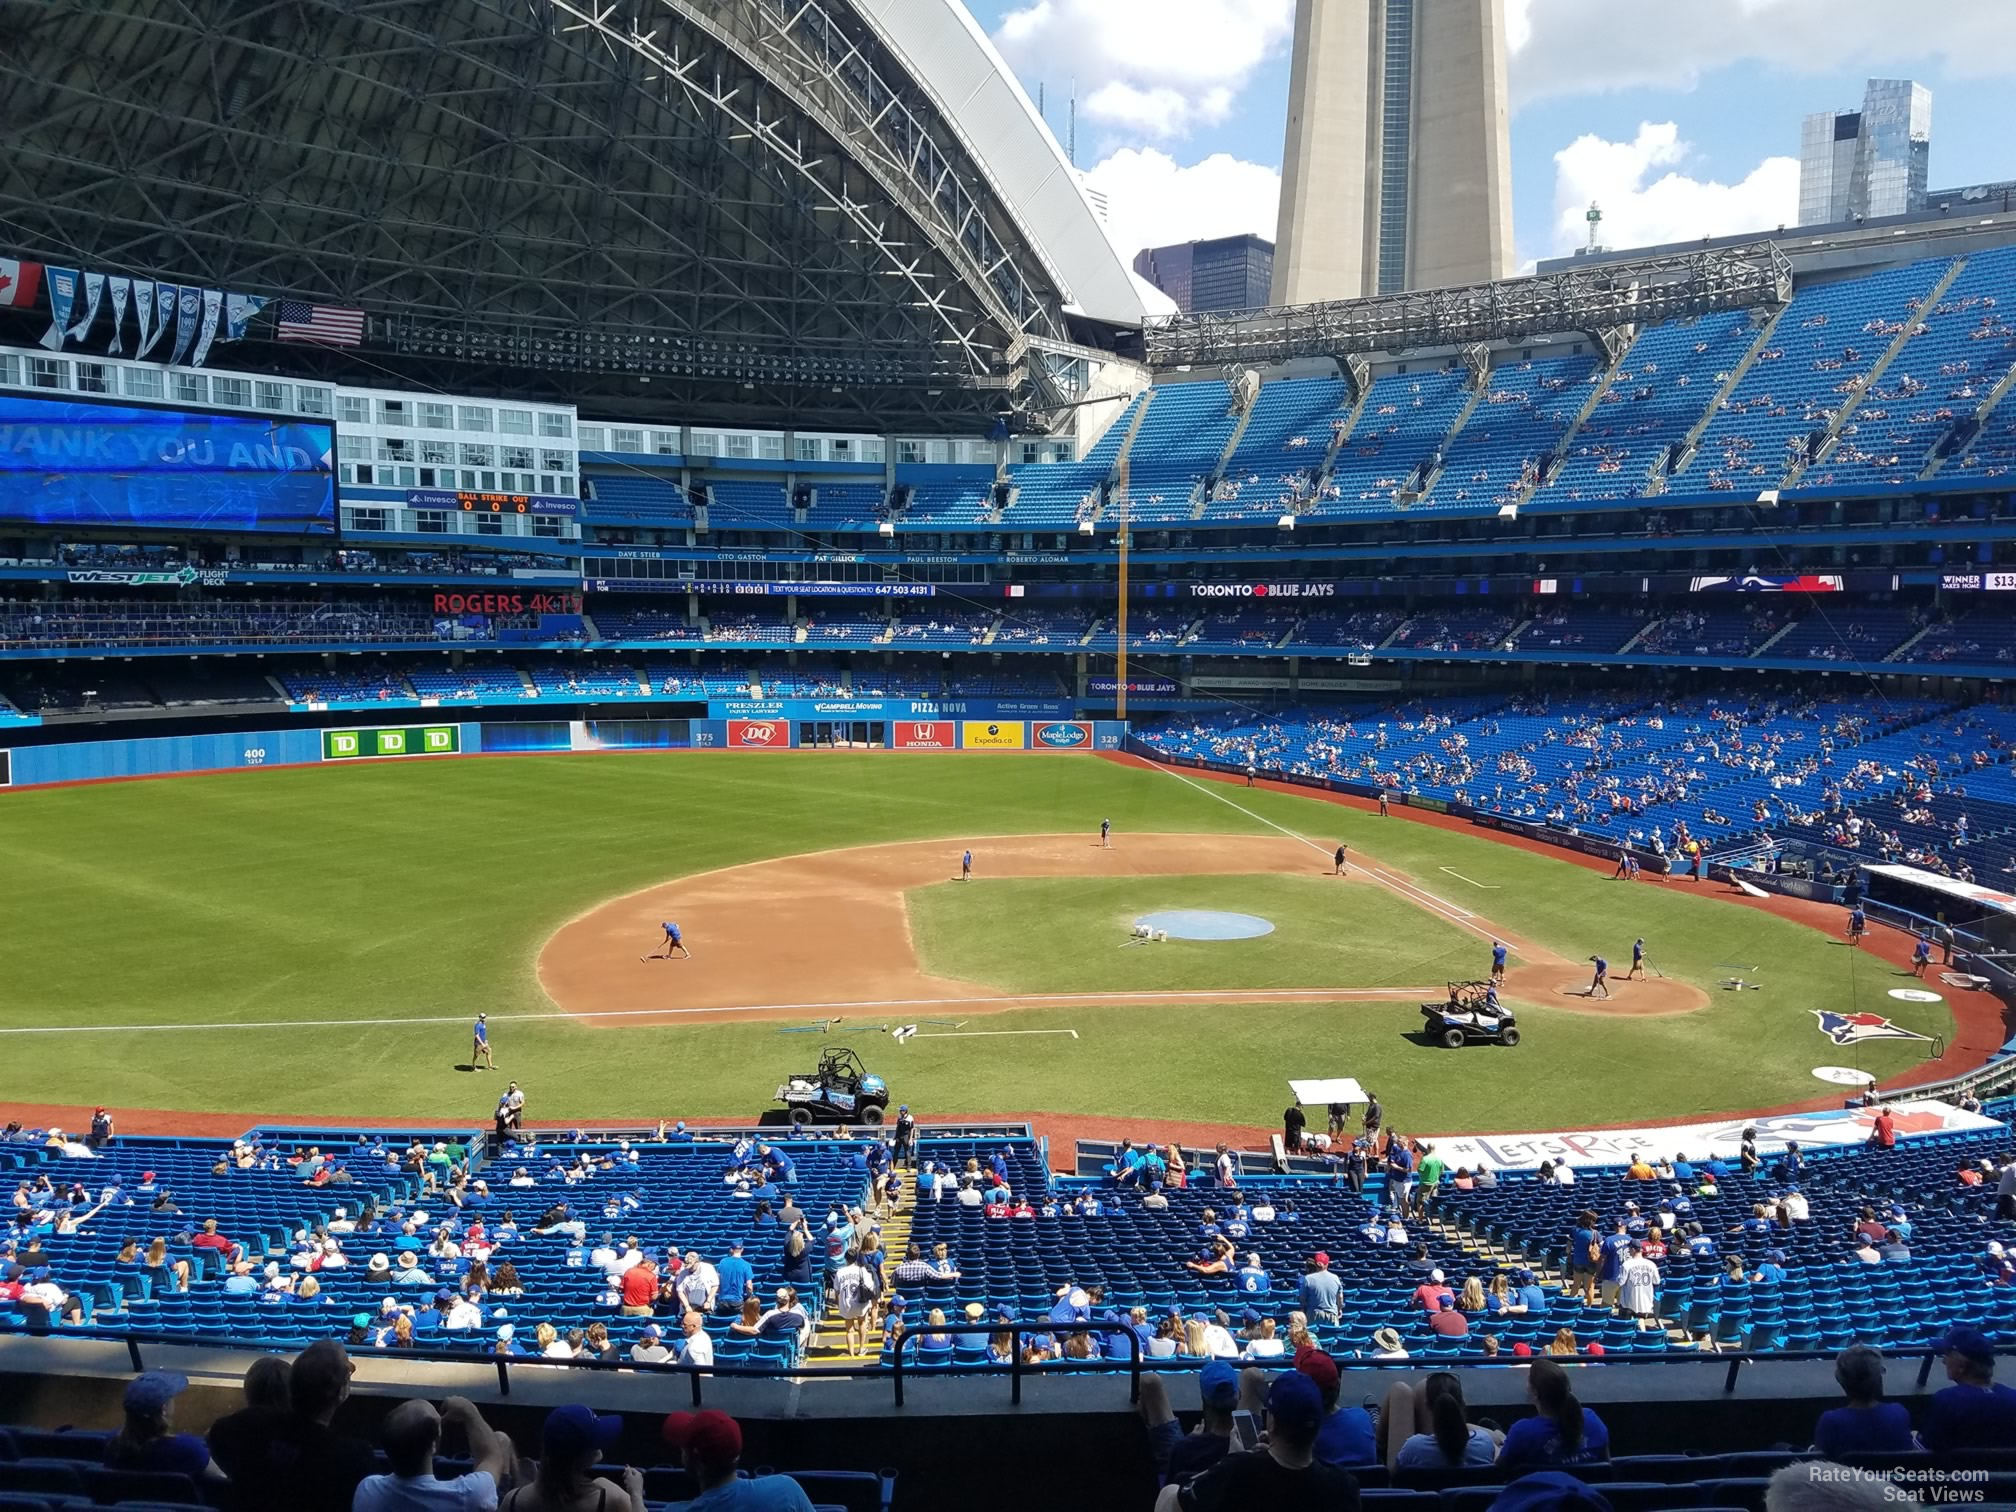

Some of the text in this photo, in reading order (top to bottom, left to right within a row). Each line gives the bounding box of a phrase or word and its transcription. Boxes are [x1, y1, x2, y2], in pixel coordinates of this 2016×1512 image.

[128, 433, 214, 466] YOU
[229, 442, 312, 471] AND
[424, 495, 456, 504] Invesco
[458, 492, 478, 500] BALL
[481, 494, 508, 502] STRIKE
[546, 502, 576, 510] Invesco
[69, 571, 180, 585] WESTJET
[200, 570, 229, 578] FLIGHT
[1943, 575, 1980, 584] WINNER
[203, 578, 226, 586] DECK
[812, 586, 837, 594] LOCATION
[842, 586, 866, 594] QUESTION
[876, 586, 892, 594] 647
[892, 586, 909, 594] 503
[910, 586, 928, 594] 4131
[1190, 584, 1334, 596] TORONTO BLUE JAYS
[434, 594, 524, 613] ROGERS
[530, 594, 555, 613] 4K
[1156, 684, 1176, 692] JAYS
[820, 702, 883, 710] CAMPBELL MOVING
[911, 702, 967, 713] PIZZA NOVA
[997, 702, 1018, 710] Active
[1020, 702, 1038, 710] Green
[1044, 702, 1059, 710] Ross
[746, 727, 772, 740] DQ
[333, 736, 356, 752] TD
[380, 735, 403, 750] TD
[426, 732, 449, 747] TD
[974, 737, 1013, 746] Expedia.ca
[1100, 736, 1118, 744] 328
[244, 748, 266, 758] 400
[1500, 821, 1524, 832] HONDA
[1584, 844, 1601, 856] Galaxy
[1817, 849, 1848, 861] American
[1746, 872, 1778, 886] Standard
[1246, 1276, 1257, 1292] 6
[1634, 1272, 1650, 1287] 20
